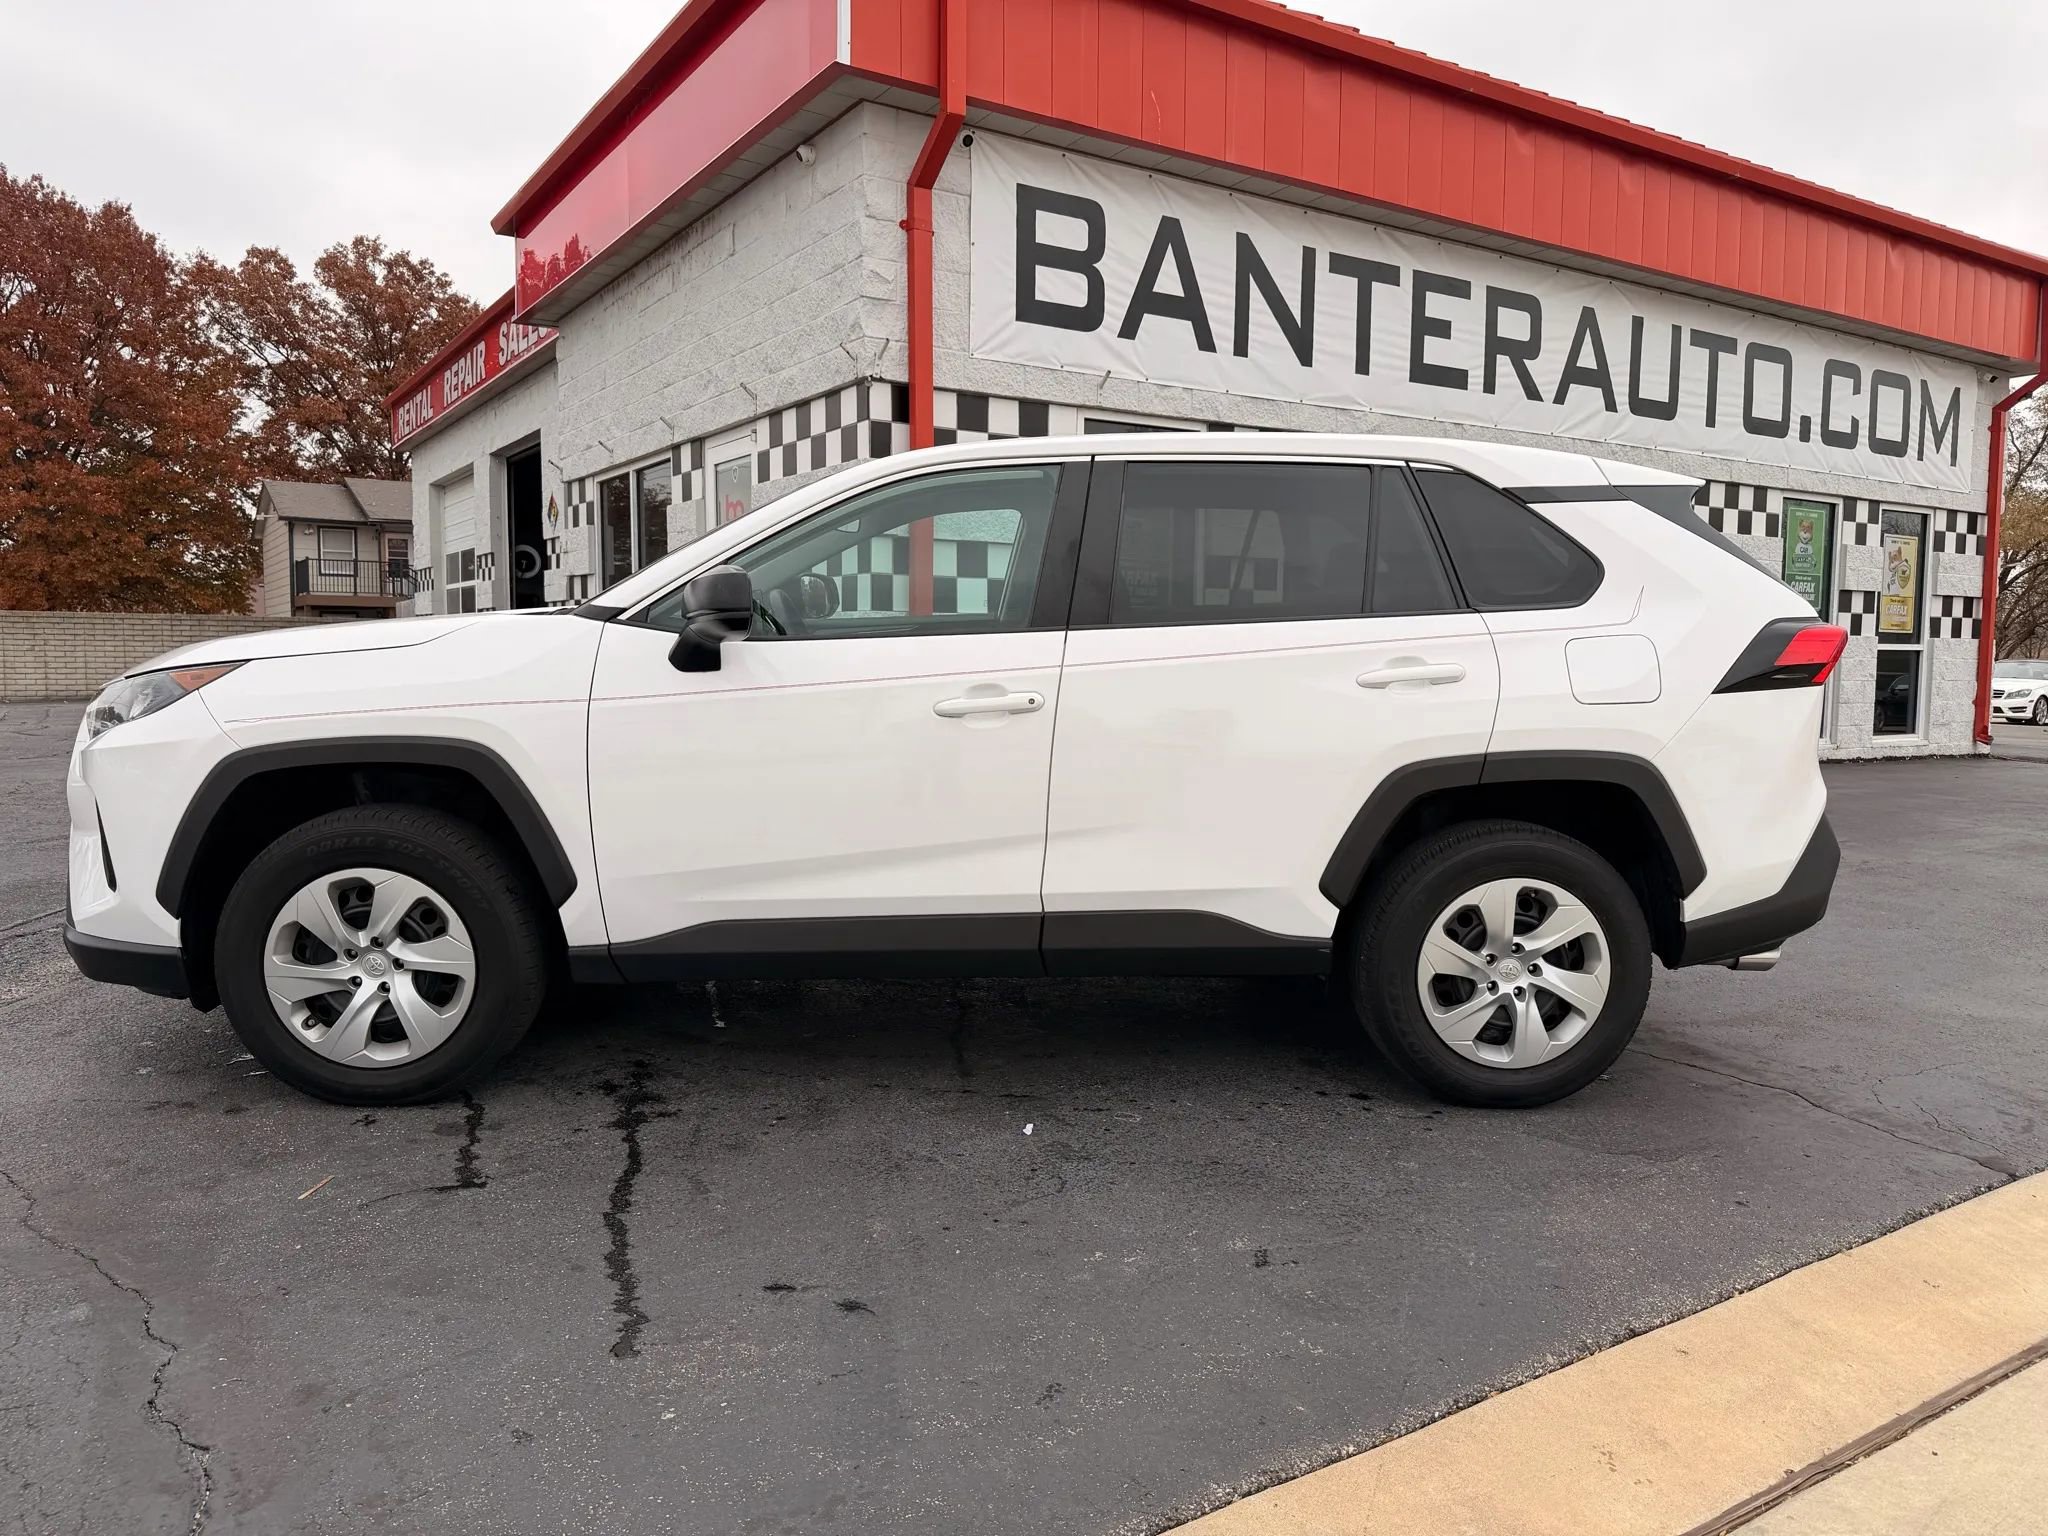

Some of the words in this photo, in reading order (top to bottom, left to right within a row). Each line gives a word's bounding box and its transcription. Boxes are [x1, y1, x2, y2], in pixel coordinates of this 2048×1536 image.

[398, 385, 434, 439] RENTAL
[443, 340, 486, 408] REPAIR
[499, 315, 547, 366] SAL
[1016, 183, 1961, 468] BANTERAUTO.COM
